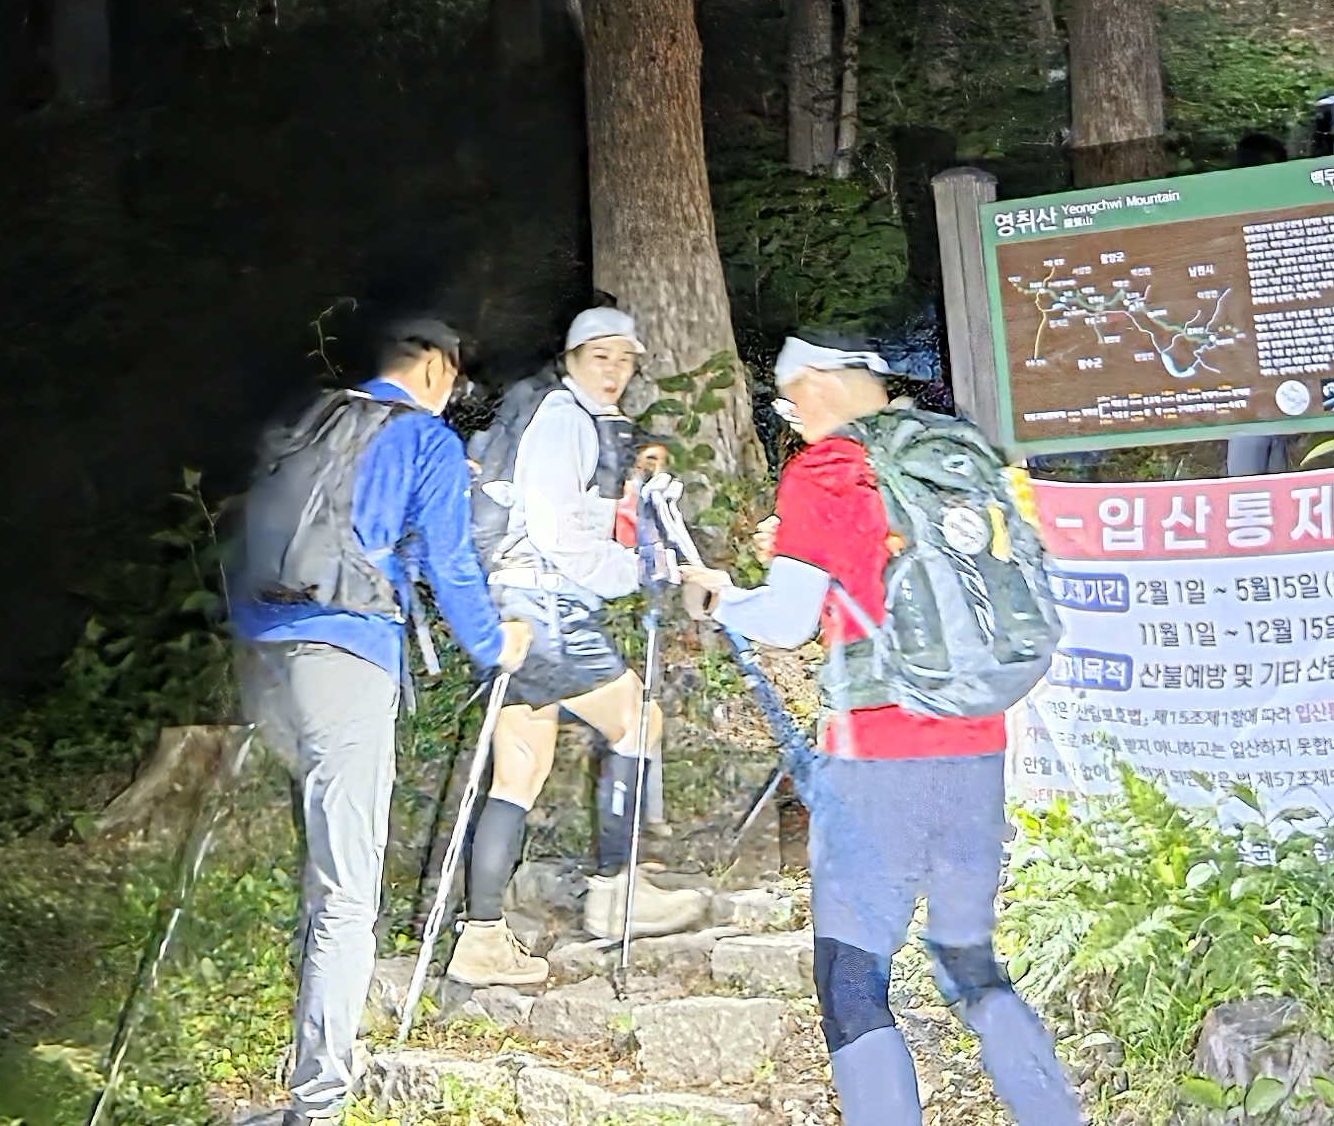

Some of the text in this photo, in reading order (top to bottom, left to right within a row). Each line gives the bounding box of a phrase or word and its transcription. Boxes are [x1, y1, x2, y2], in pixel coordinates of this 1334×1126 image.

[1060, 189, 1180, 216] Yeongchwi Mountain
[994, 205, 1058, 237] 영취산
[1245, 618, 1293, 644] 12월
[1139, 663, 1227, 690] 산불예방
[1234, 663, 1253, 689] 및
[1261, 660, 1302, 687] 기타
[1262, 706, 1291, 724] 따라
[1230, 738, 1292, 758] 입산하지
